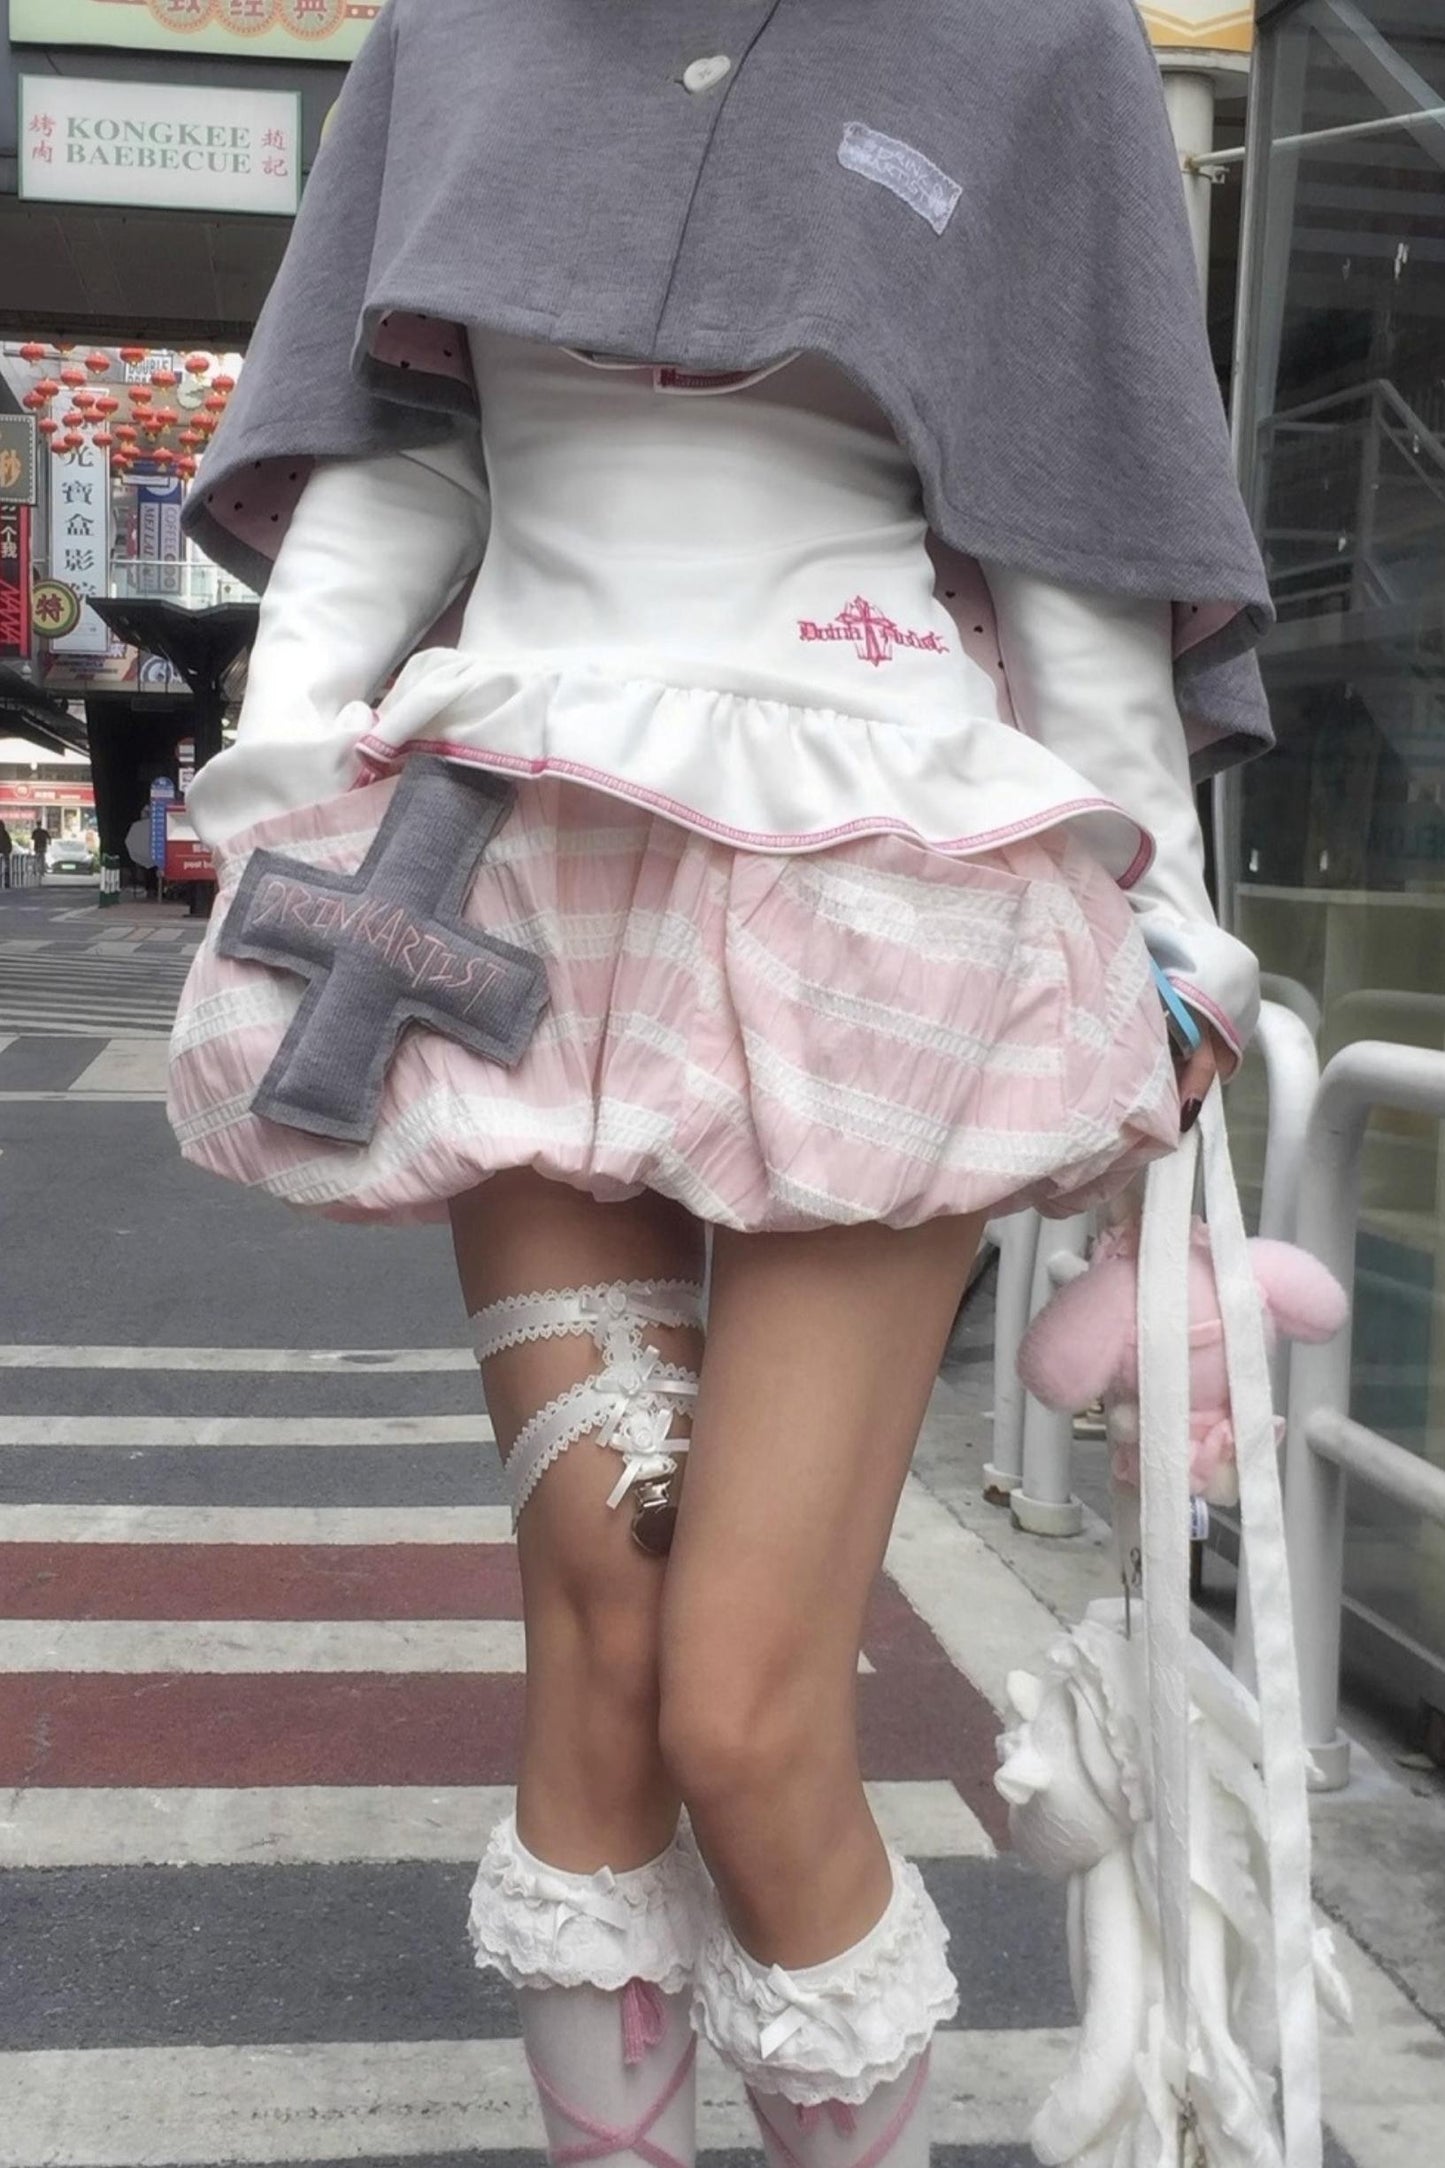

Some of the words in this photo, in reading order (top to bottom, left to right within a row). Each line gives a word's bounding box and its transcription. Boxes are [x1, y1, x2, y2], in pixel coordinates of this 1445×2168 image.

[27, 113, 57, 164] 烤肉
[66, 116, 251, 149] KONGKEE
[66, 143, 252, 175] BAEBECUE
[35, 593, 64, 623] 特
